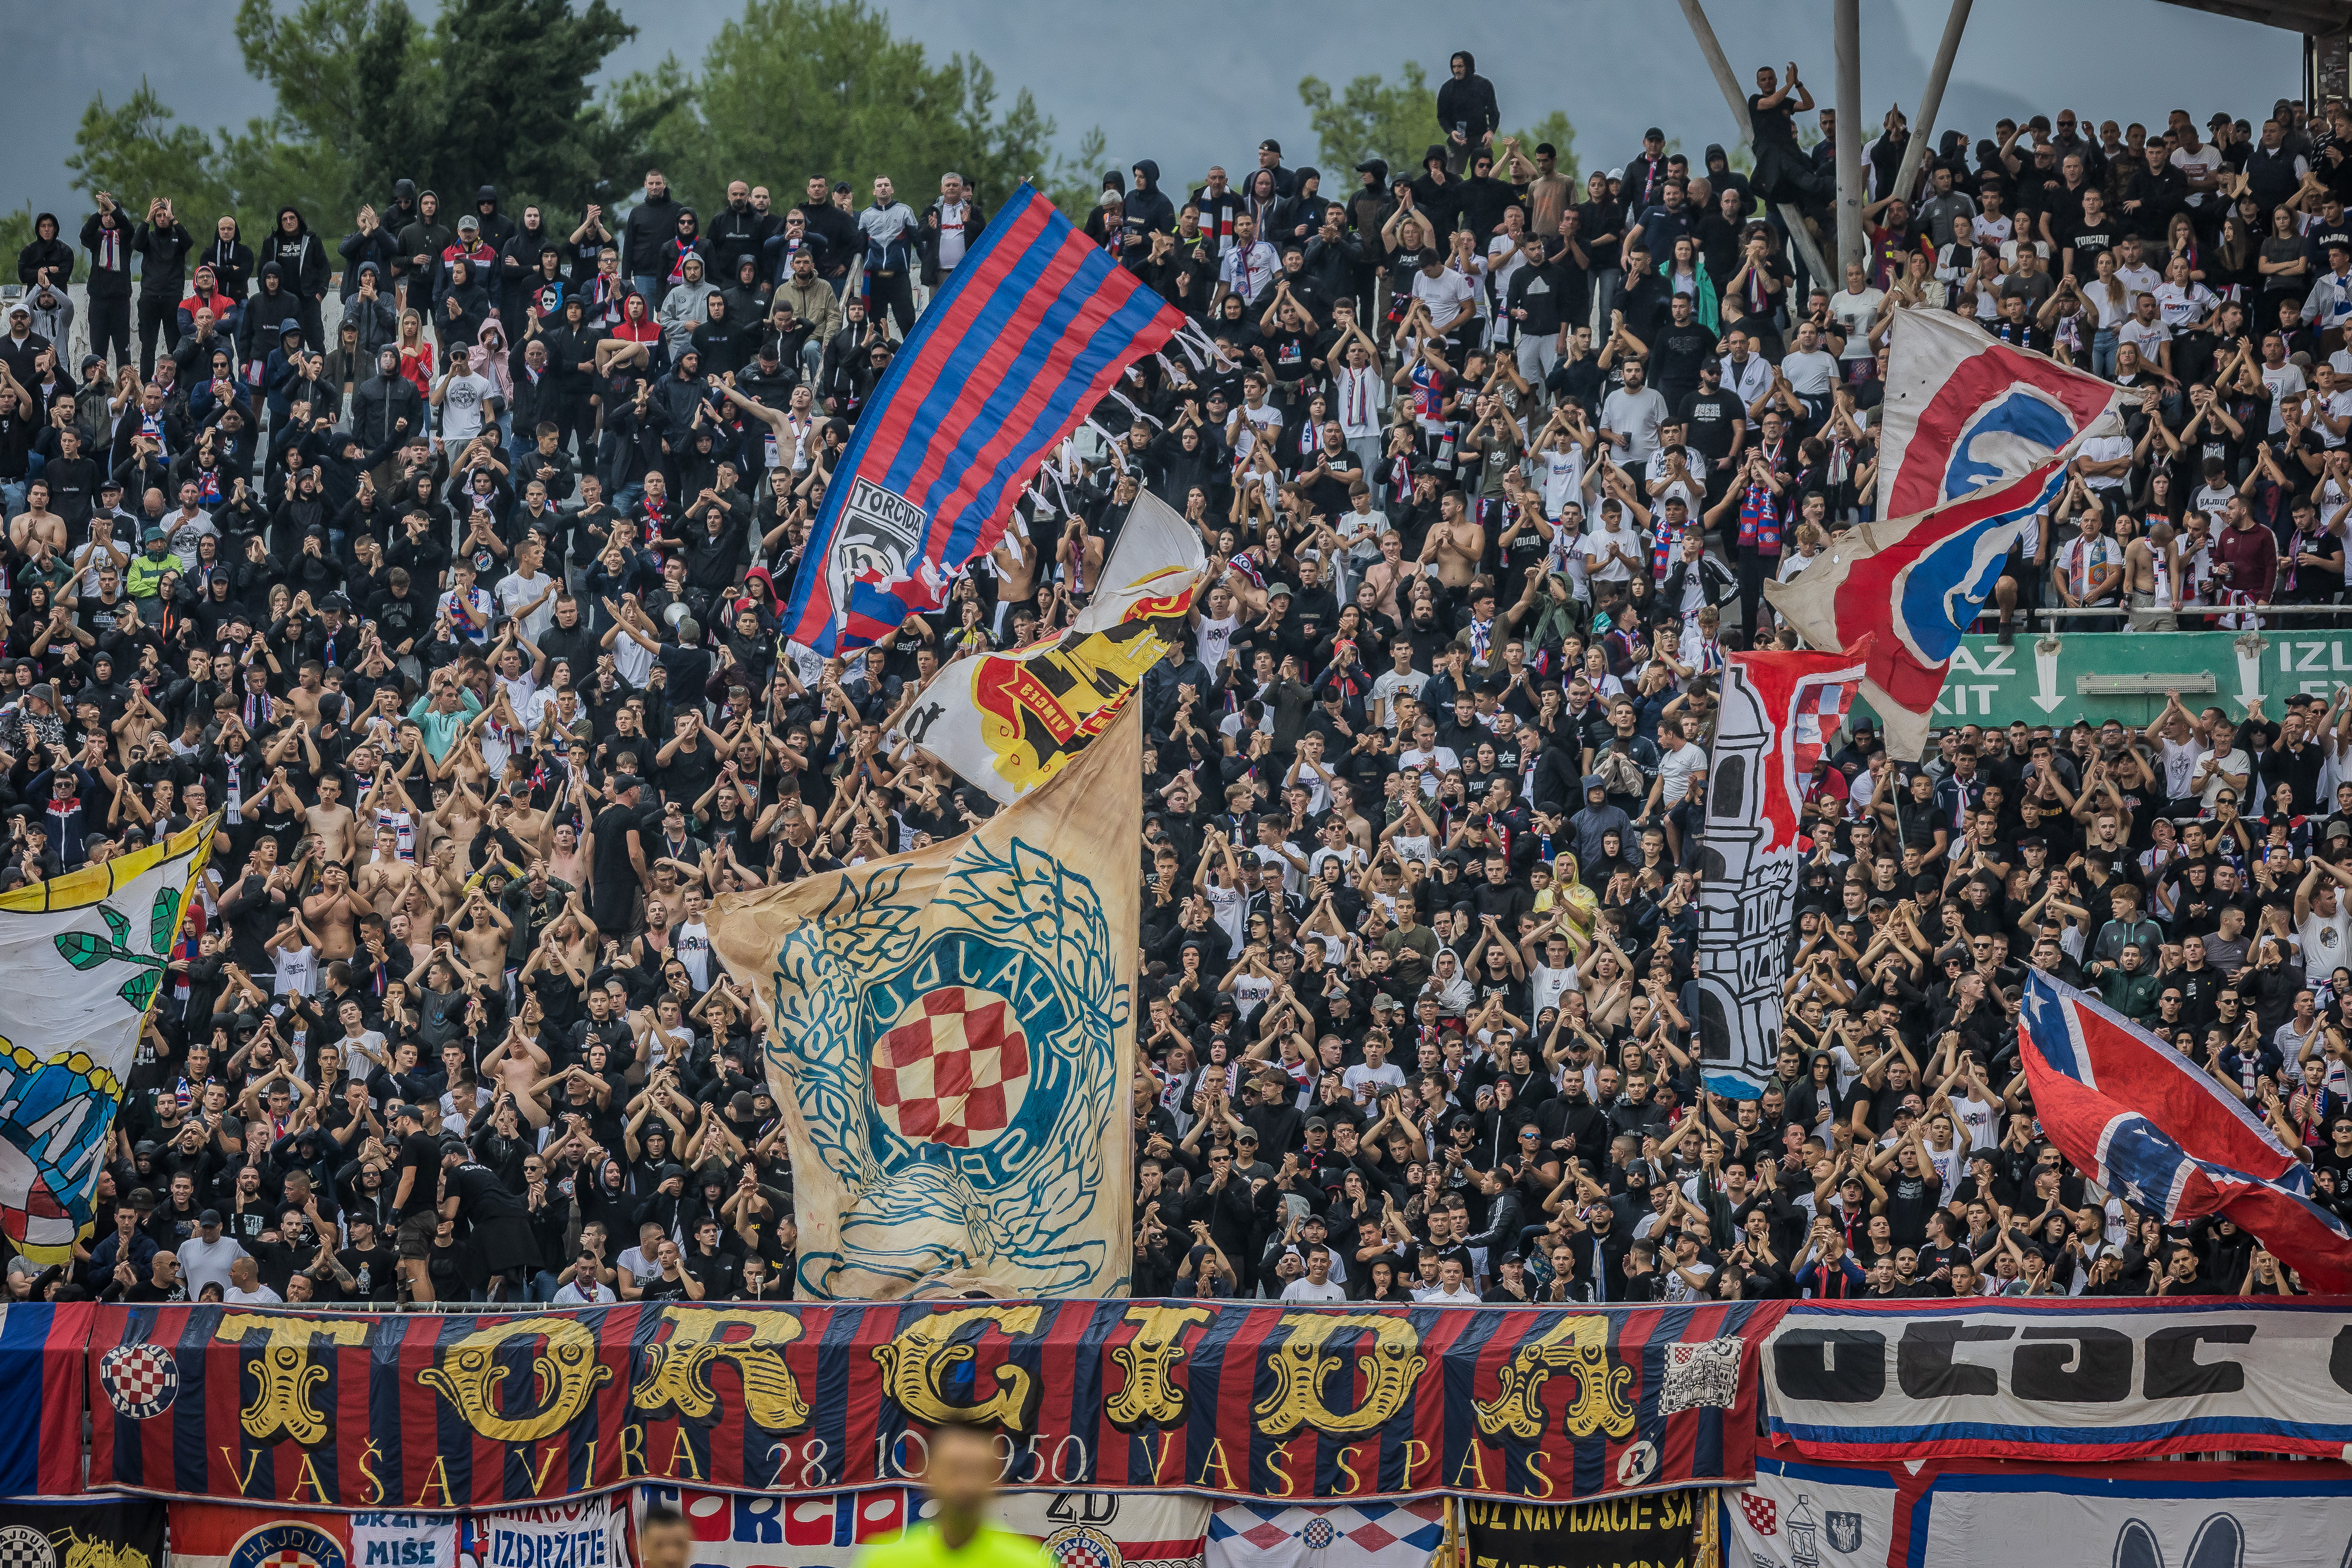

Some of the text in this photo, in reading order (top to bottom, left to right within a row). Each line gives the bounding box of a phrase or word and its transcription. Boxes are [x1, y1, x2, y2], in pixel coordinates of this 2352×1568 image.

[2075, 235, 2109, 249] TORCIDA
[857, 483, 921, 538] TORCIDA
[2280, 641, 2352, 671] IZL
[1937, 684, 1999, 715] XIT
[108, 1342, 172, 1367] HAJDUK
[213, 1304, 1636, 1443] TORCIDA
[112, 1393, 161, 1418] SPLIT
[220, 1437, 456, 1507] VAŠA
[514, 1424, 704, 1496] VIRA
[765, 1437, 836, 1490] 28.
[875, 1429, 928, 1480] 10
[994, 1433, 1089, 1485] 950.
[1306, 1518, 1332, 1530] HAJDUK
[0, 1530, 48, 1552] AJDUK
[242, 1529, 338, 1567] HAJDUK
[364, 1537, 436, 1566] MIŠE
[493, 1529, 605, 1568] IZDRŽITE
[1054, 1538, 1105, 1562] HAJDUK
